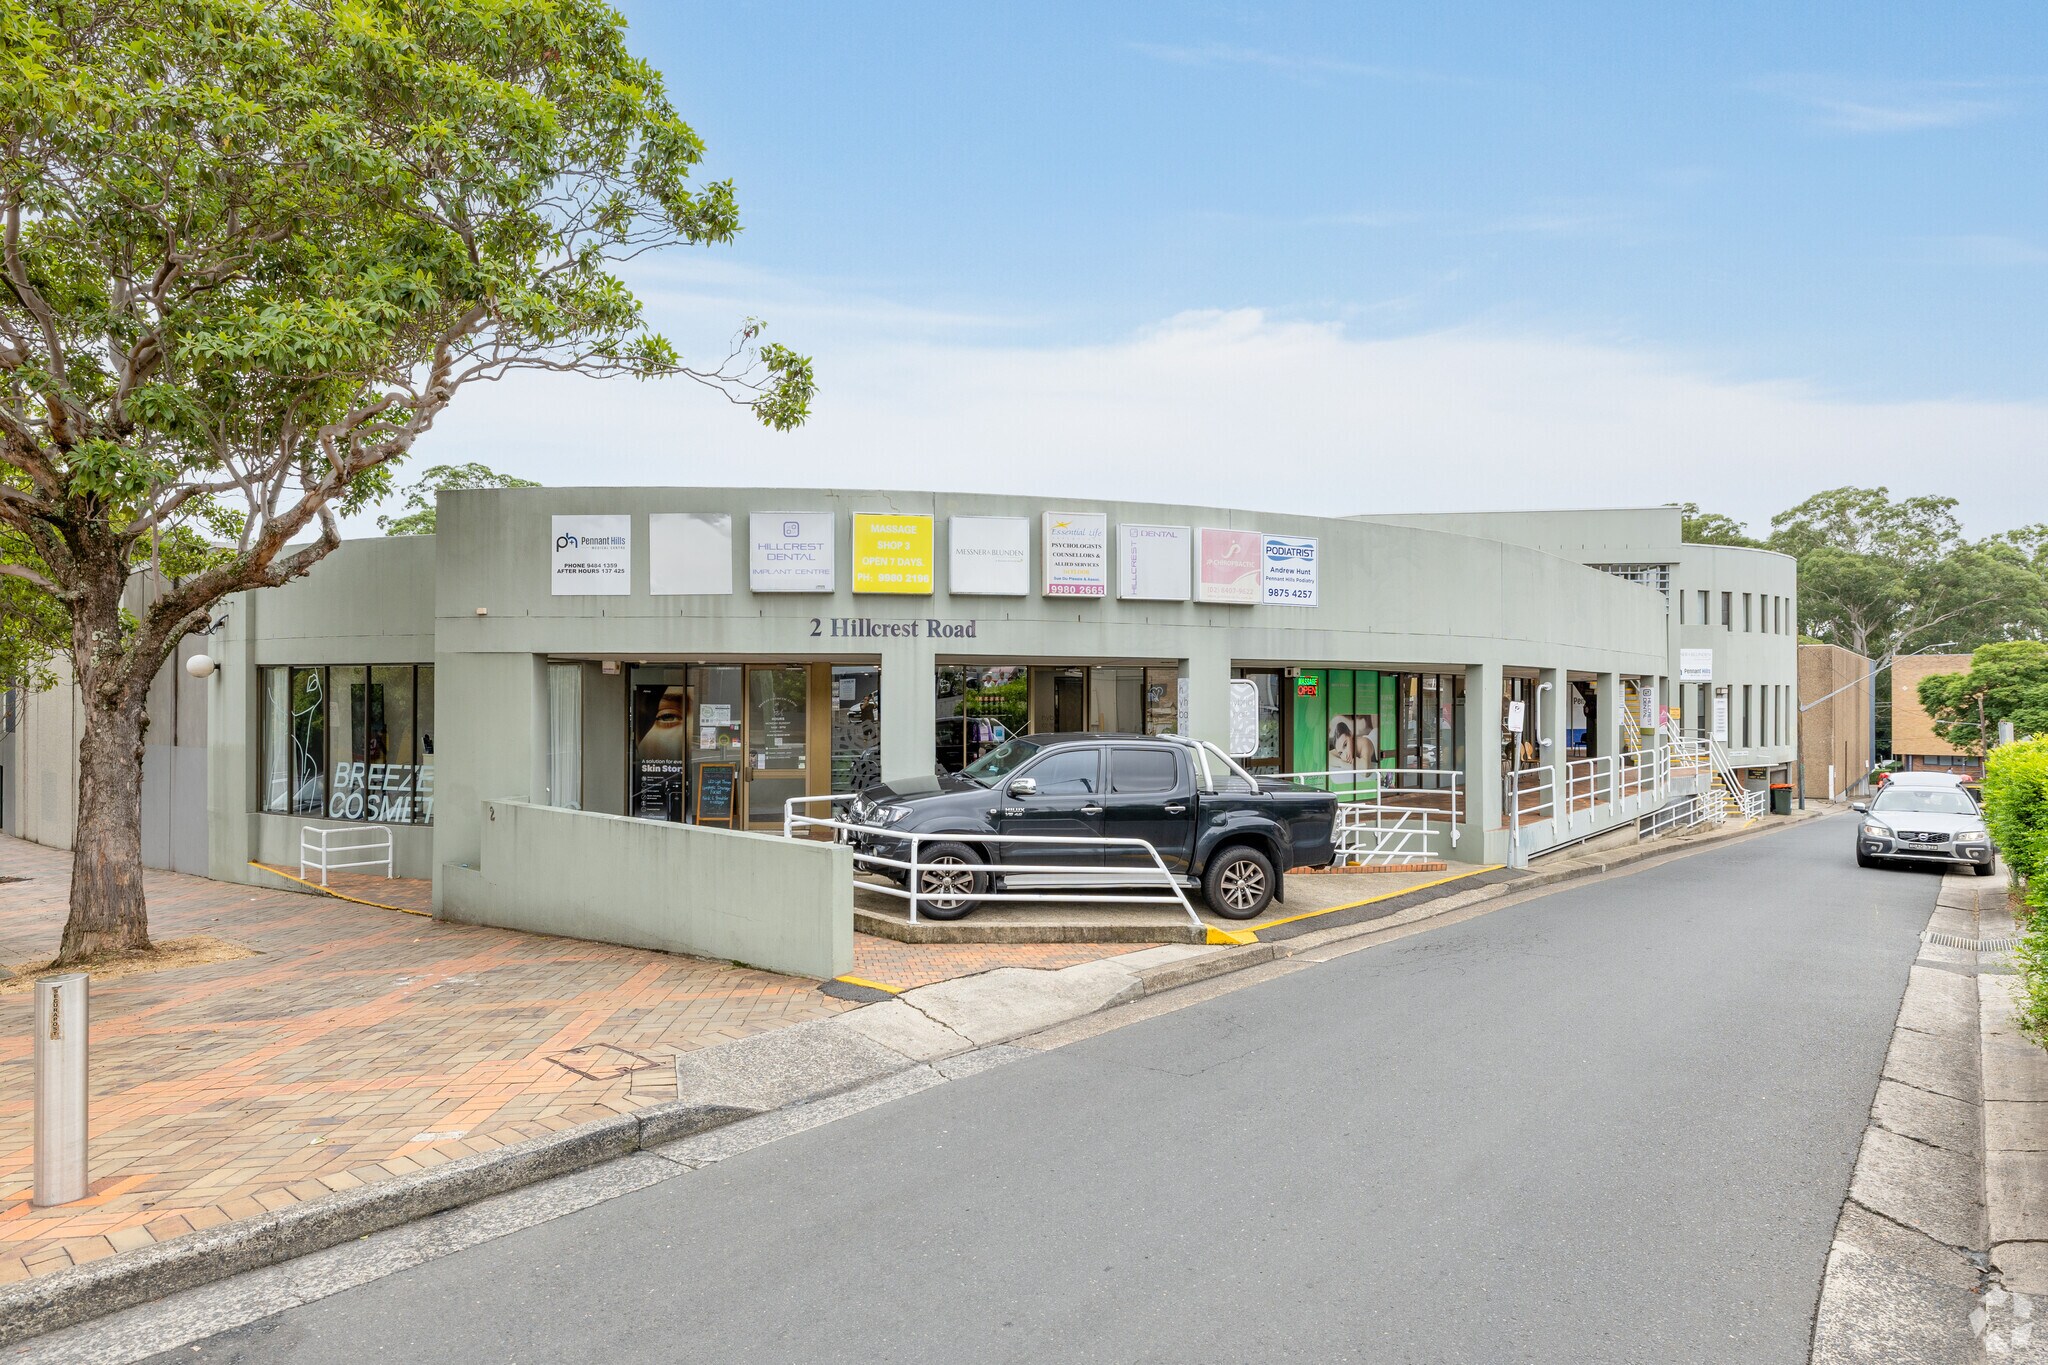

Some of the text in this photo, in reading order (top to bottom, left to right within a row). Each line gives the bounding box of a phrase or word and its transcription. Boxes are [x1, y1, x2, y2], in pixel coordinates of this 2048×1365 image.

[871, 524, 917, 535] MASSAGE
[1051, 528, 1102, 538] Essential Life
[1140, 530, 1179, 539] DENTAL
[581, 536, 610, 545] Pennant
[610, 536, 626, 545] Hills
[757, 543, 825, 551] HILLCREST
[877, 541, 911, 551] SHOP 3
[766, 553, 816, 561] DENTAL
[955, 548, 987, 556] MESSNER
[991, 549, 1024, 557] BLUNDEN
[1265, 546, 1315, 558] PODIATRIST
[862, 556, 888, 566] OPEN
[889, 557, 896, 566] 7
[1130, 540, 1138, 596] HILLCREST
[1050, 585, 1104, 595] 9980 2665
[1268, 588, 1313, 599] 9875 4257
[809, 617, 977, 639] 2 Hillcrest Road
[1297, 677, 1317, 686] MASSAGE
[1297, 686, 1317, 695] OPEN
[334, 761, 434, 792] BREEZE
